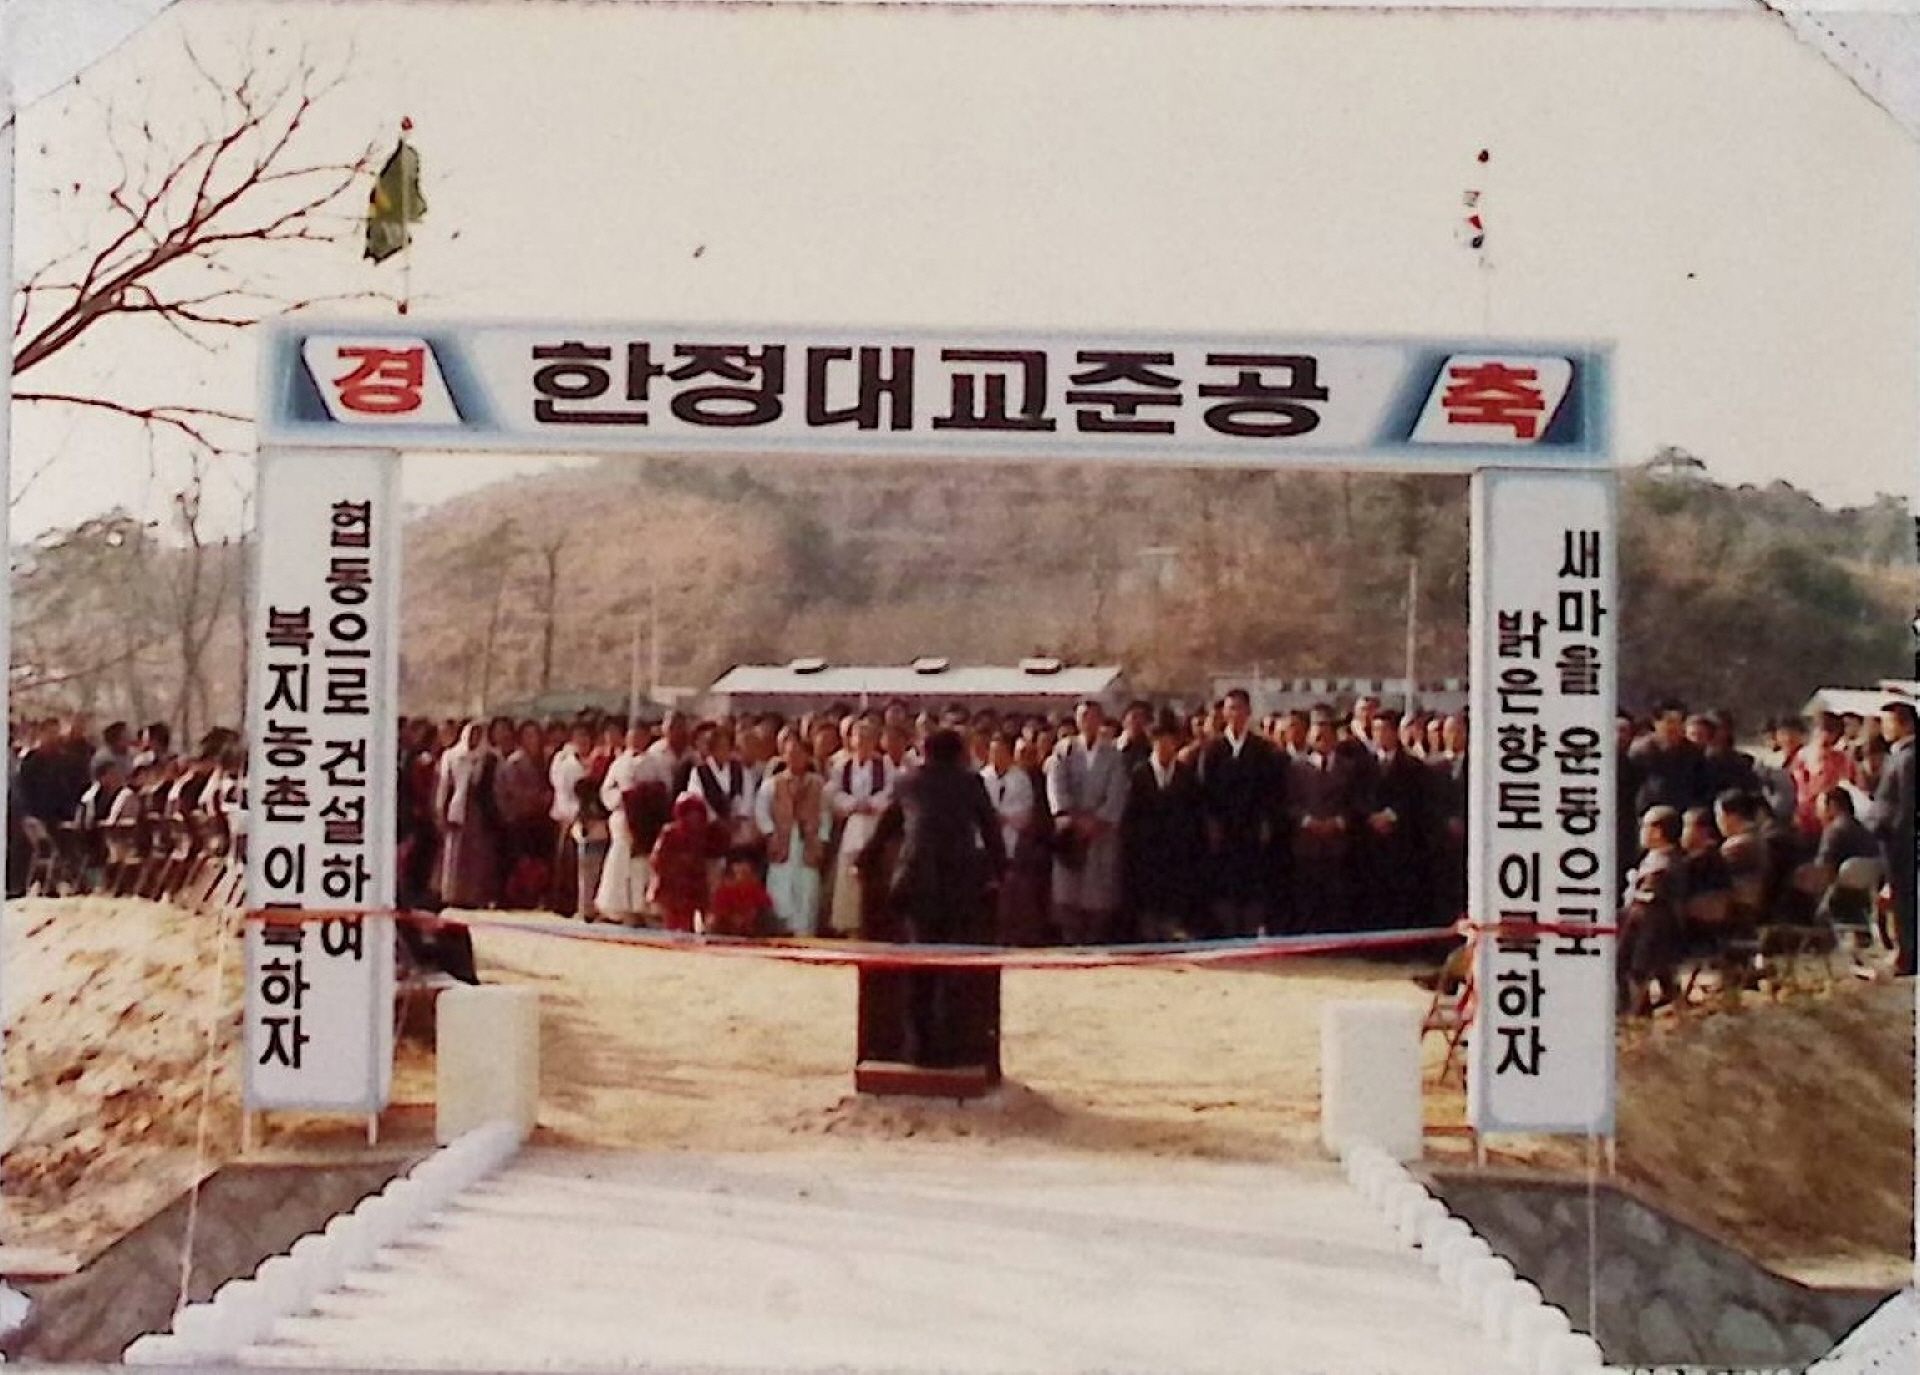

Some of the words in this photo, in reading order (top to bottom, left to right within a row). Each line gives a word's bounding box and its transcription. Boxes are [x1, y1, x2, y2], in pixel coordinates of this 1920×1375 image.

[333, 346, 425, 416] 경
[531, 340, 1330, 438] 한정대교준공
[1439, 361, 1548, 440] 축
[1555, 529, 1608, 696] 새마을
[261, 606, 315, 822] 복지농촌
[319, 739, 371, 960] 건설하여
